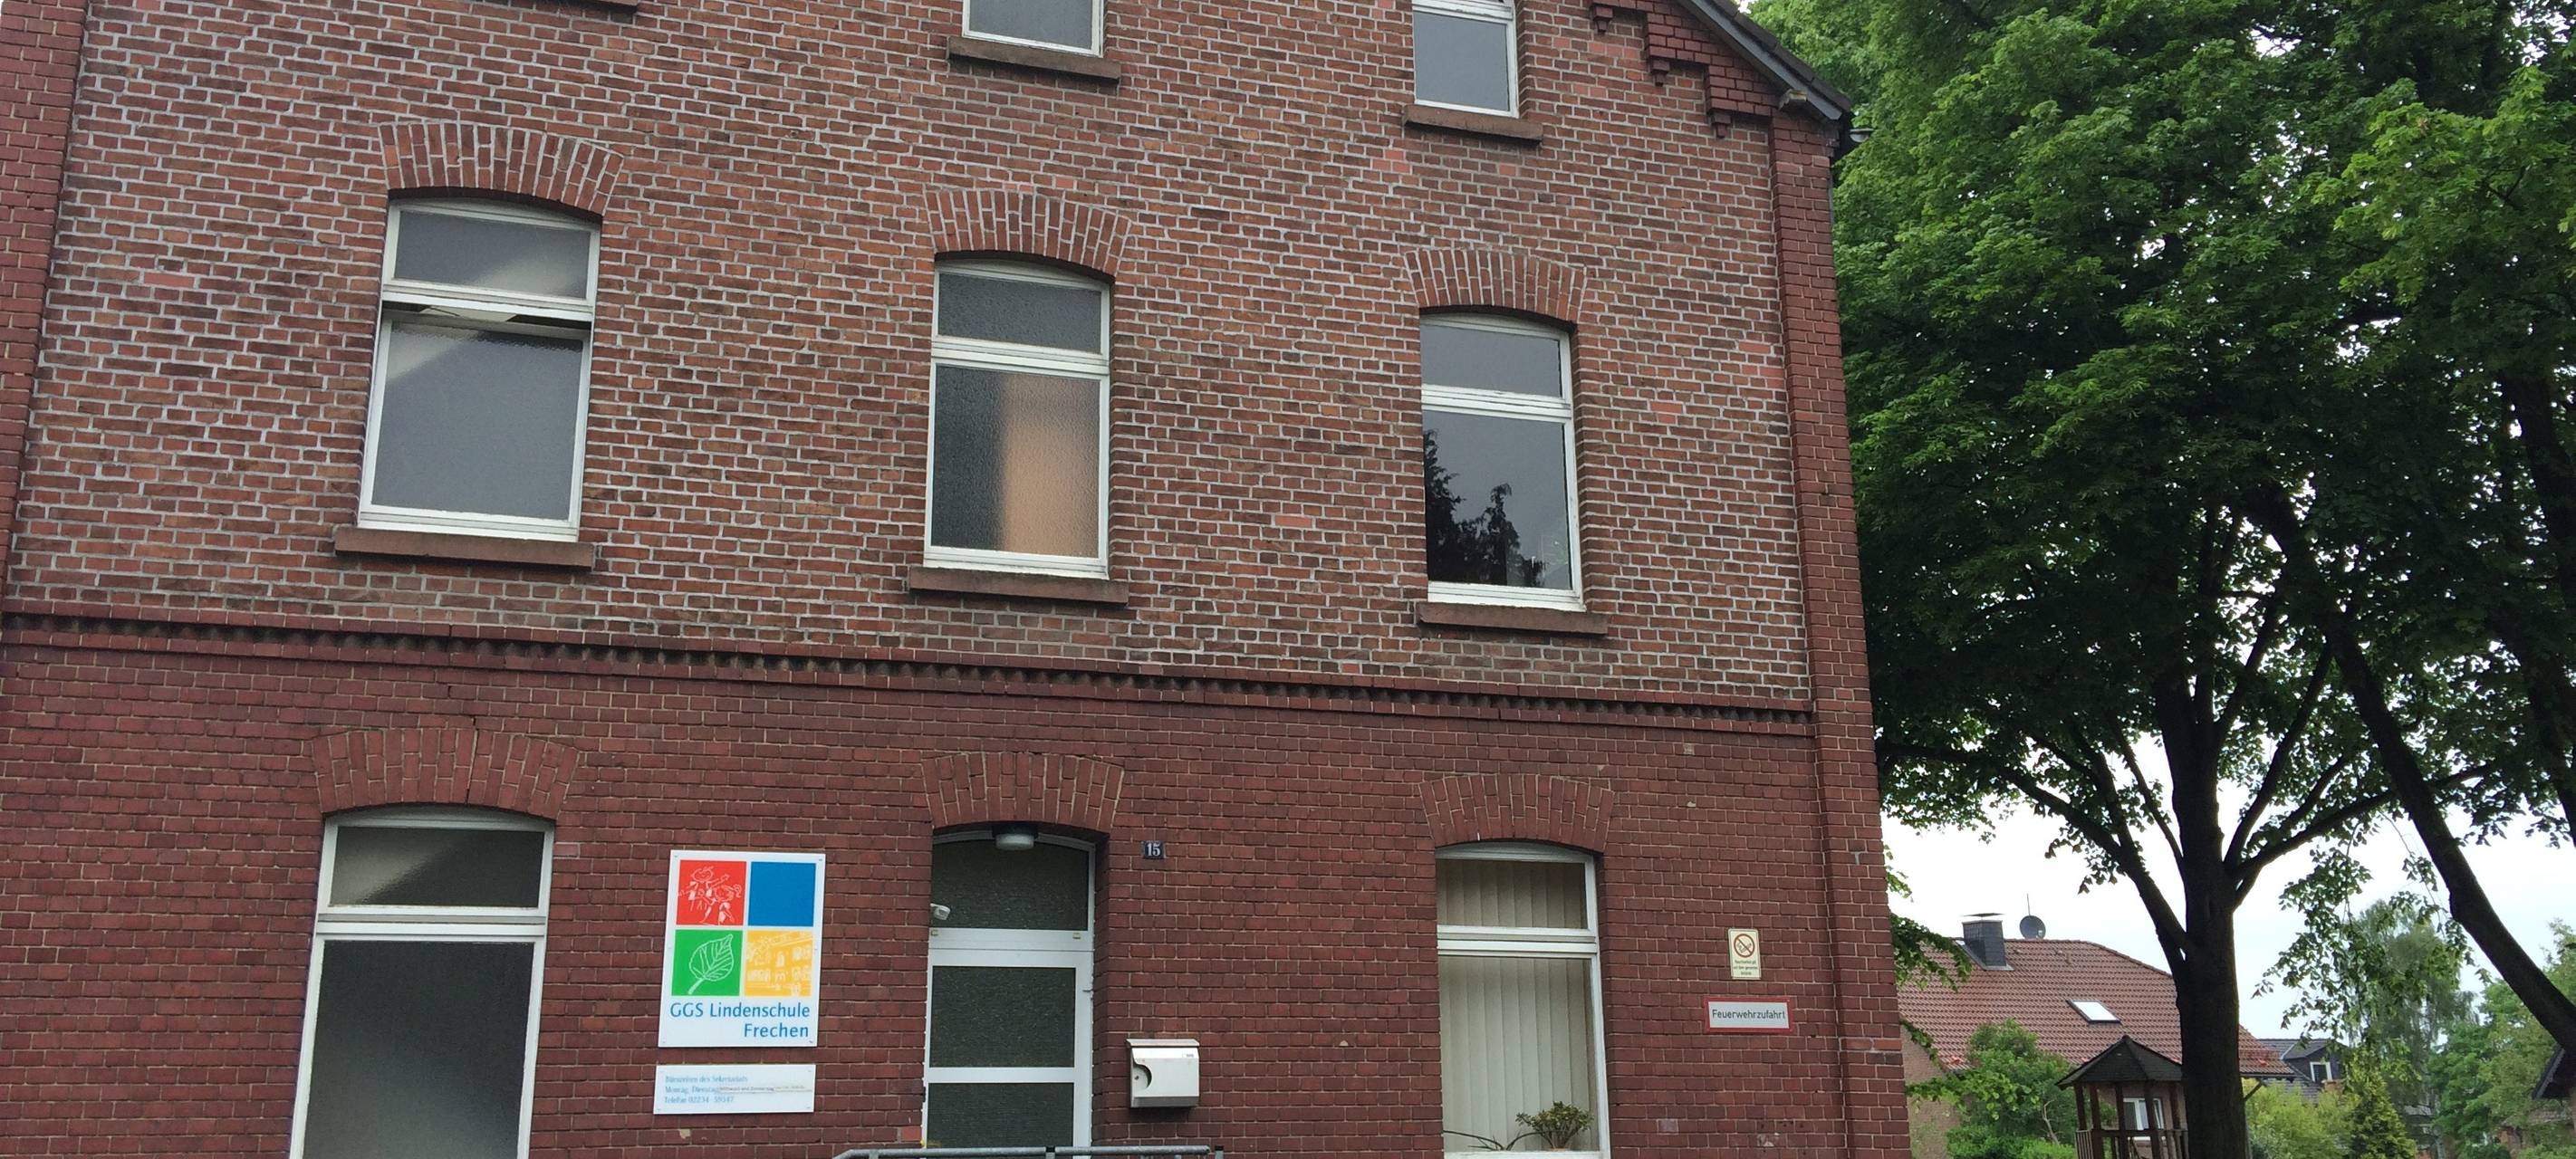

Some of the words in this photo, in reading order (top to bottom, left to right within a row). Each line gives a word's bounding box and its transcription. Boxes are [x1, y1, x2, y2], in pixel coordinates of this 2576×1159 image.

[1147, 842, 1160, 857] 15
[669, 1002, 704, 1018] GGS
[710, 1001, 811, 1018] Lindenschule
[1712, 1009, 1785, 1020] Feuerwehrzufahrt
[744, 1022, 809, 1038] Frechen
